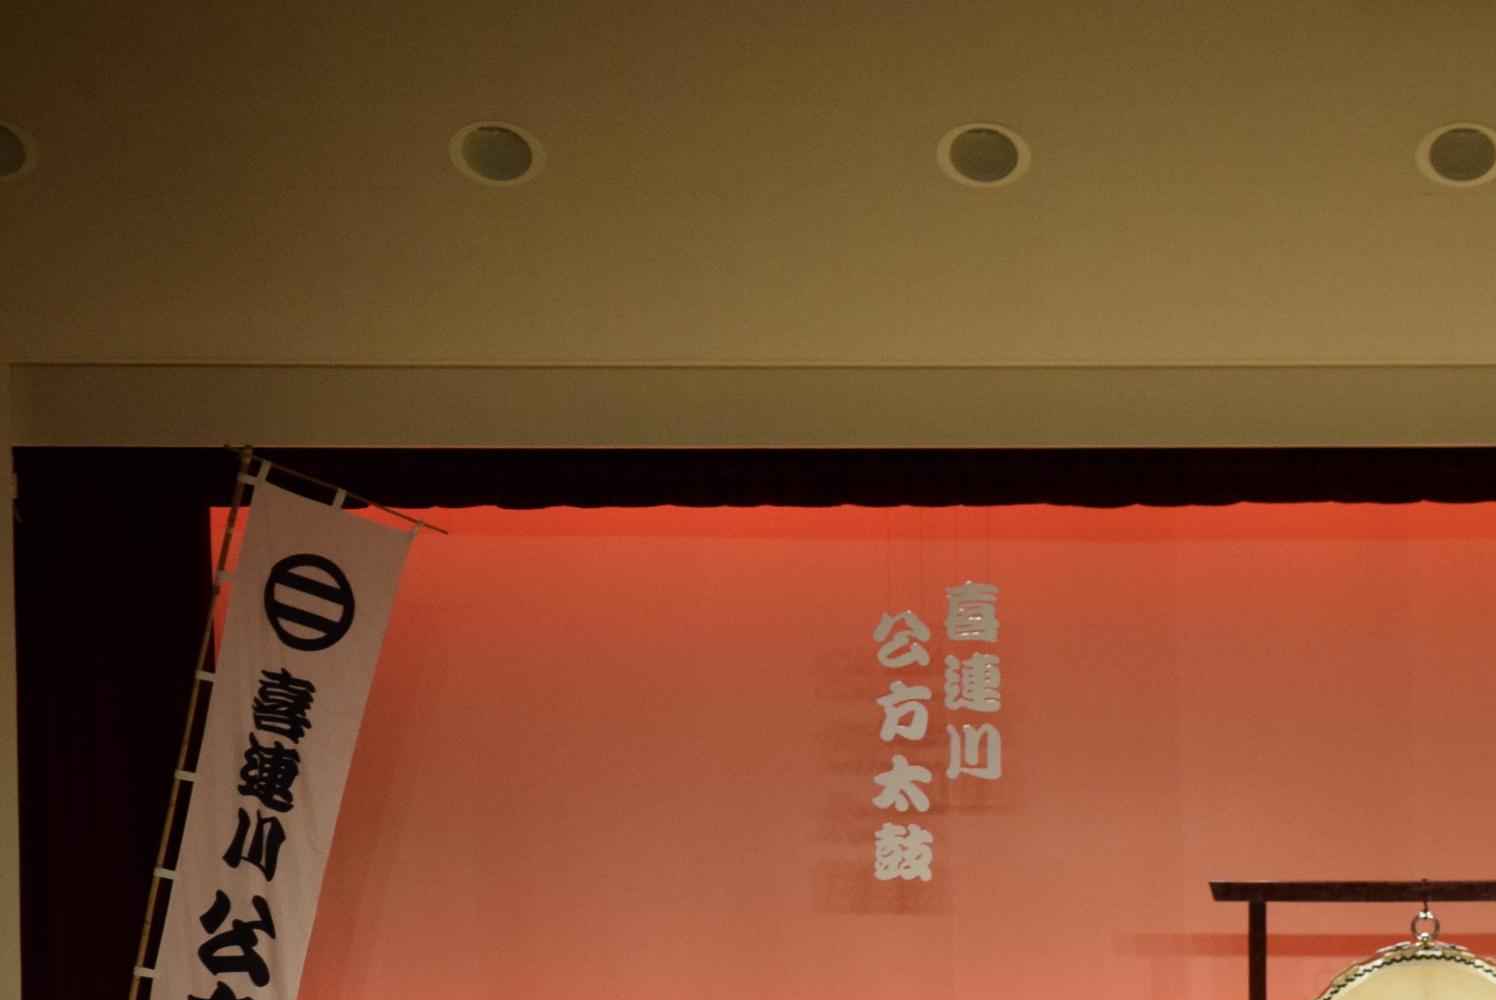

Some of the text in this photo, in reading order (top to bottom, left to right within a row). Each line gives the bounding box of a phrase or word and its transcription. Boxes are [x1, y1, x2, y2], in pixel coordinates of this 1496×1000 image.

[872, 610, 933, 882] 公方太鼓
[945, 580, 1001, 780] 喜連川
